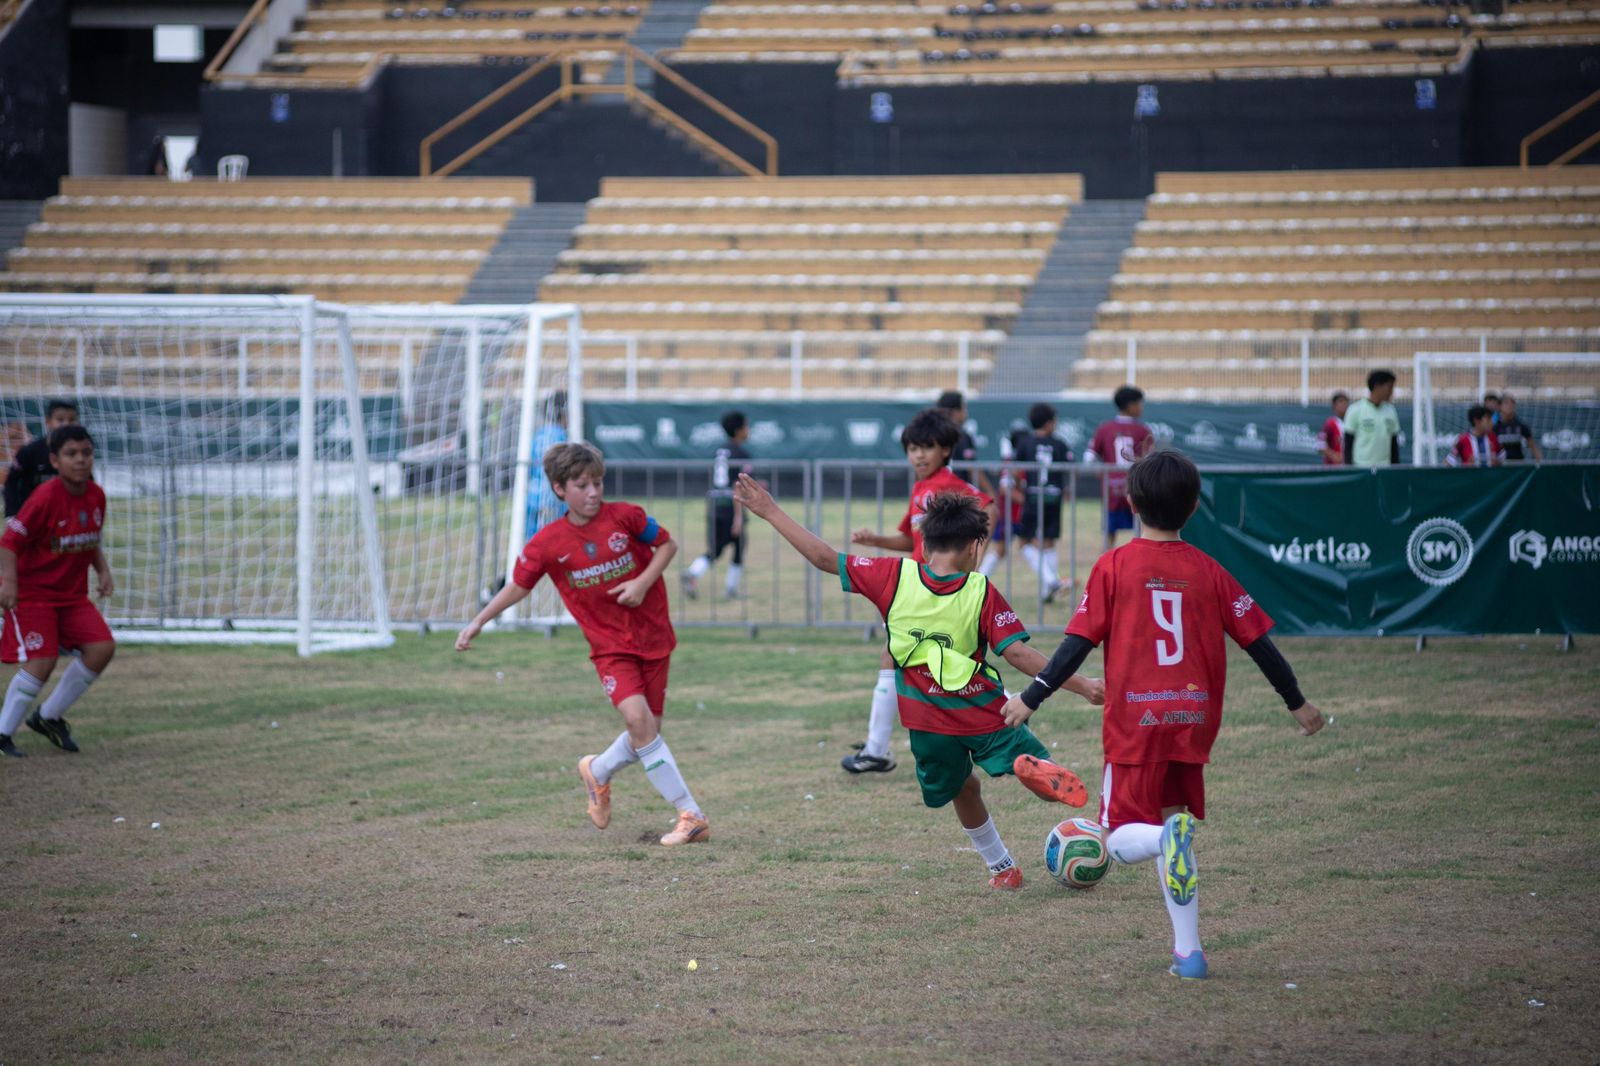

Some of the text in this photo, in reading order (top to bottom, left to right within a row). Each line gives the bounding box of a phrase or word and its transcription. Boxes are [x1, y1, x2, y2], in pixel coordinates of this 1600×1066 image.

[1422, 540, 1458, 562] 3M
[1548, 550, 1600, 563] CONSTR
[1152, 590, 1184, 666] 9
[1126, 689, 1180, 703] Fundación
[1162, 710, 1205, 725] AFIRME
